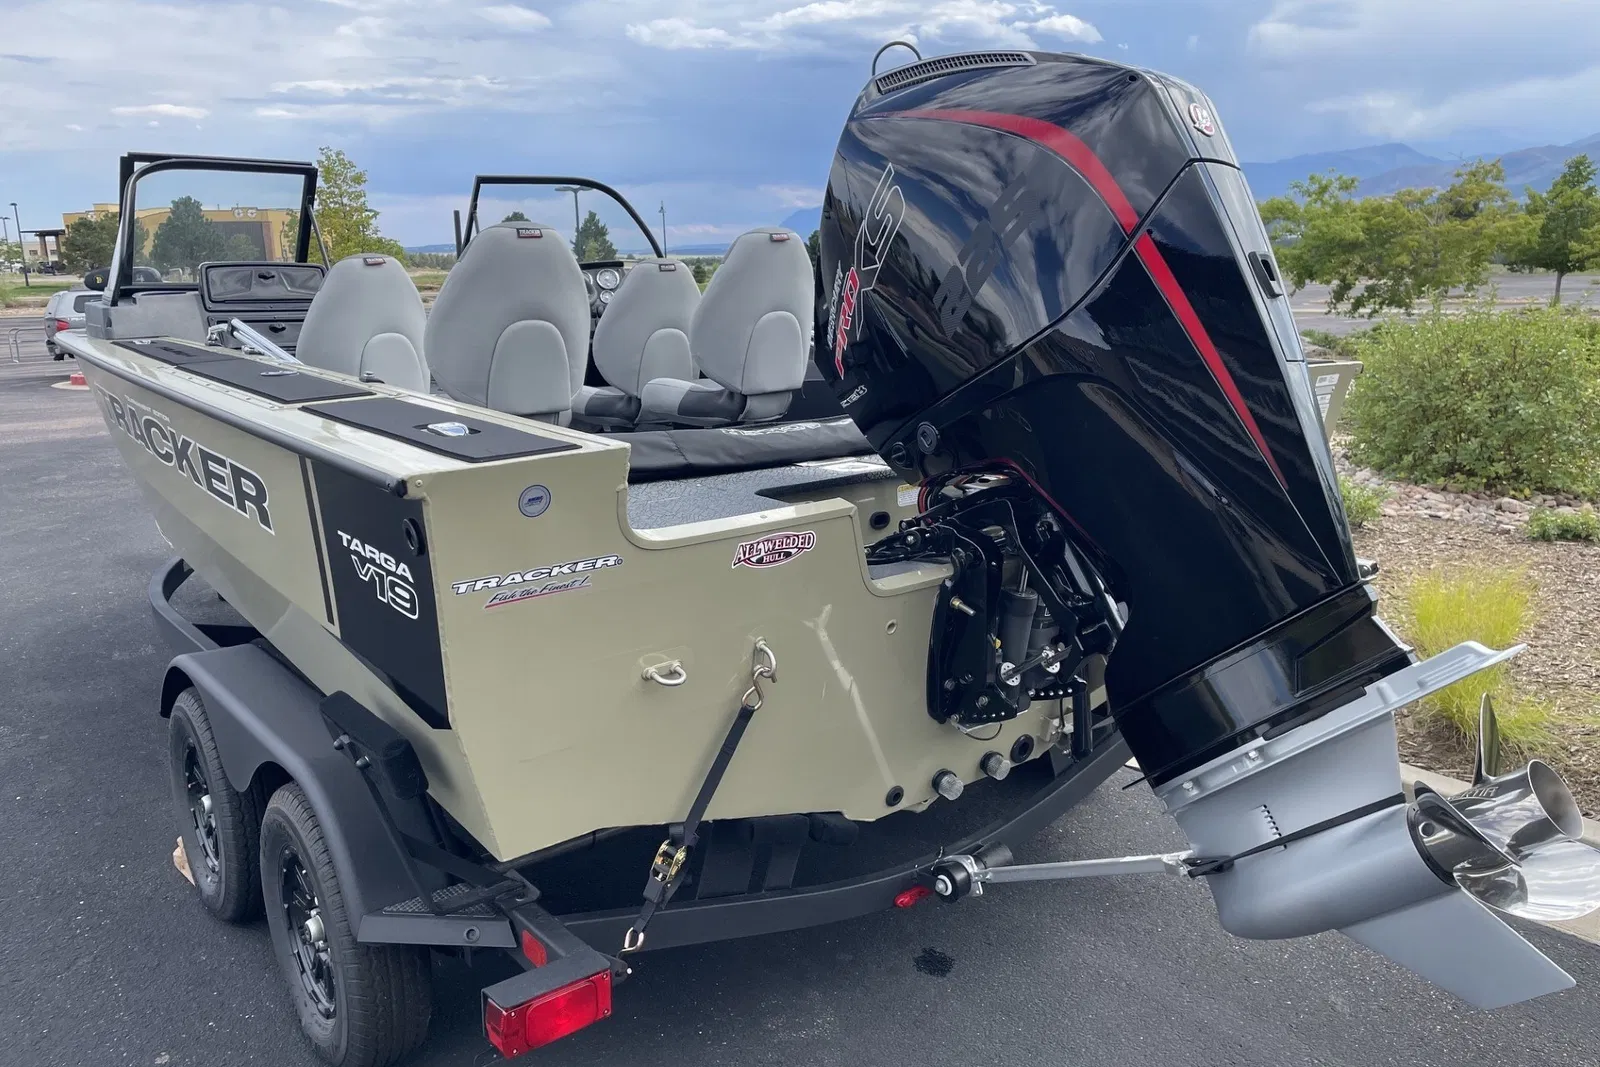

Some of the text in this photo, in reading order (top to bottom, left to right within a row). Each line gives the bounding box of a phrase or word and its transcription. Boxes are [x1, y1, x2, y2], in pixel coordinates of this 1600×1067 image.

[855, 162, 905, 341] XS
[835, 267, 859, 380] PRO
[94, 381, 275, 536] TRACKER
[337, 529, 414, 583] TARGA
[734, 533, 815, 564] ALL WELDED
[762, 552, 786, 563] HULL
[350, 554, 419, 619] V19
[489, 591, 517, 603] Fish
[519, 587, 538, 598] the
